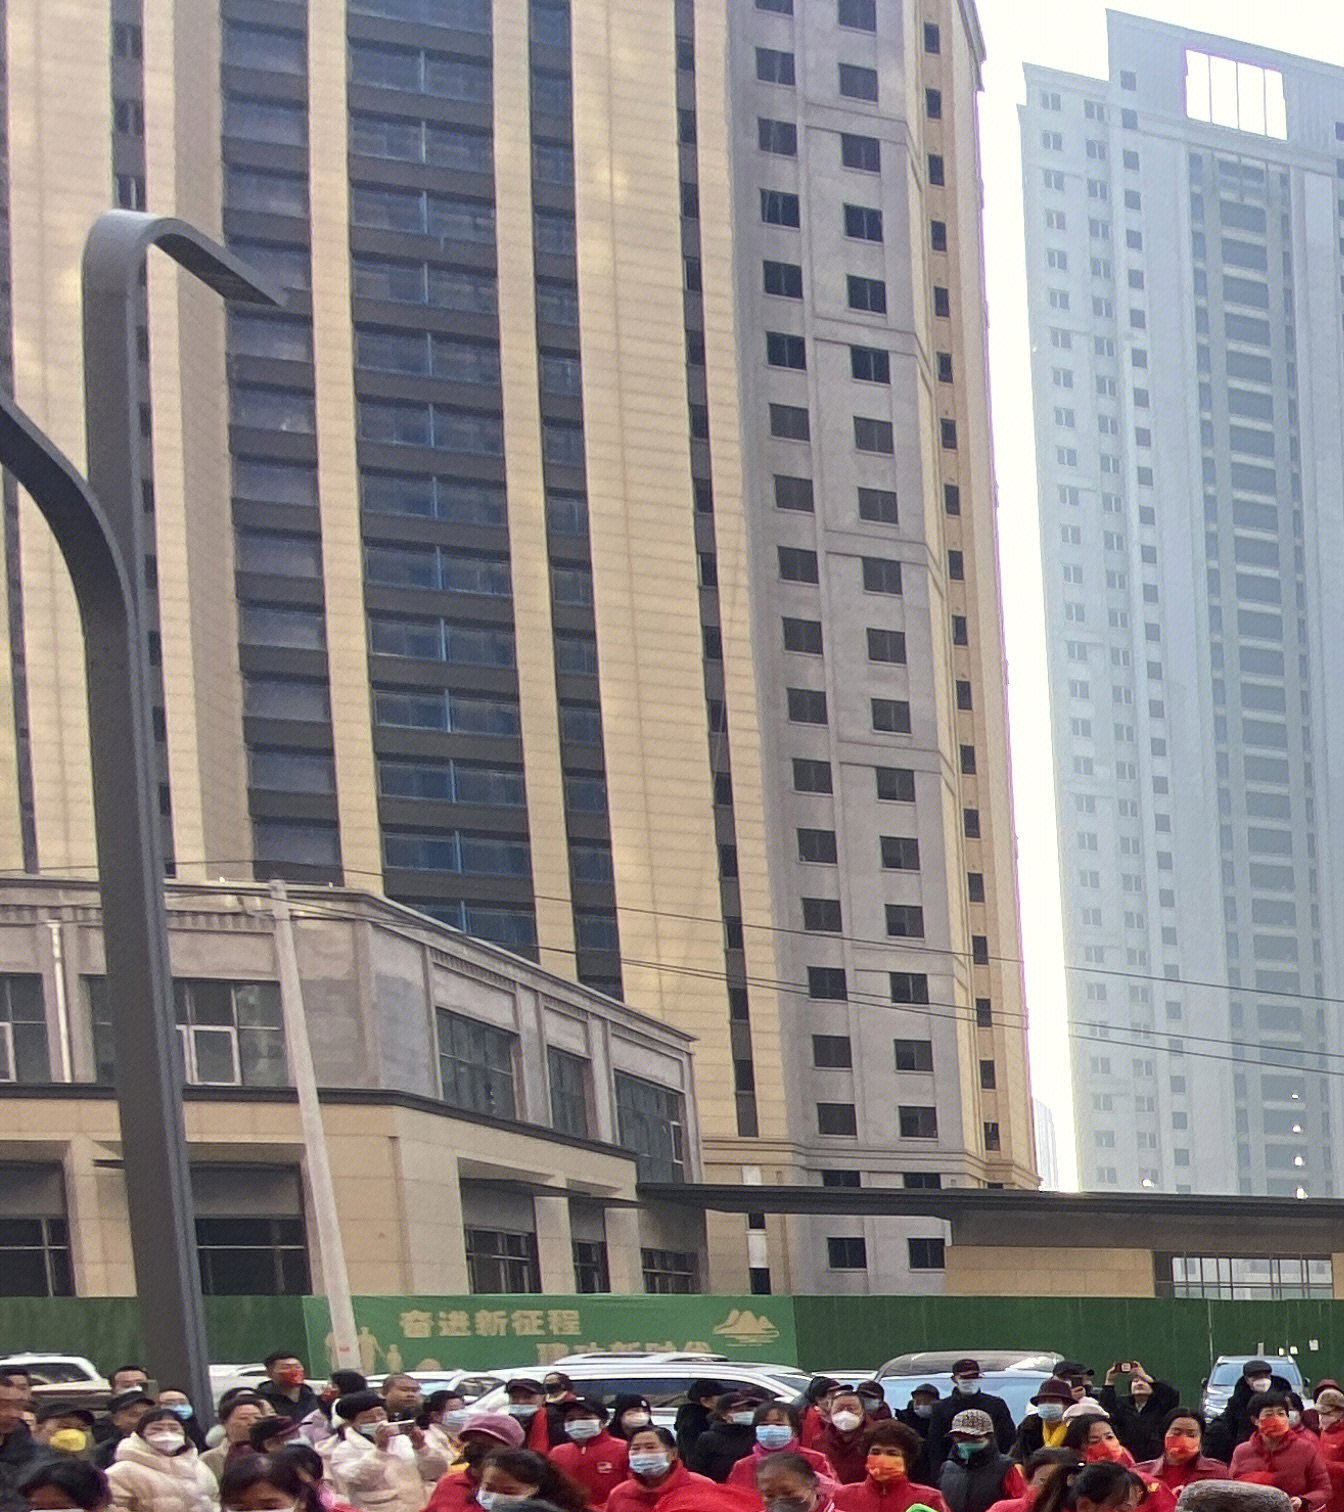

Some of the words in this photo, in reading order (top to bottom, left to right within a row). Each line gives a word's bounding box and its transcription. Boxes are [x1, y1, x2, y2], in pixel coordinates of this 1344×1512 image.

[400, 1309, 582, 1337] 奋进新征程
